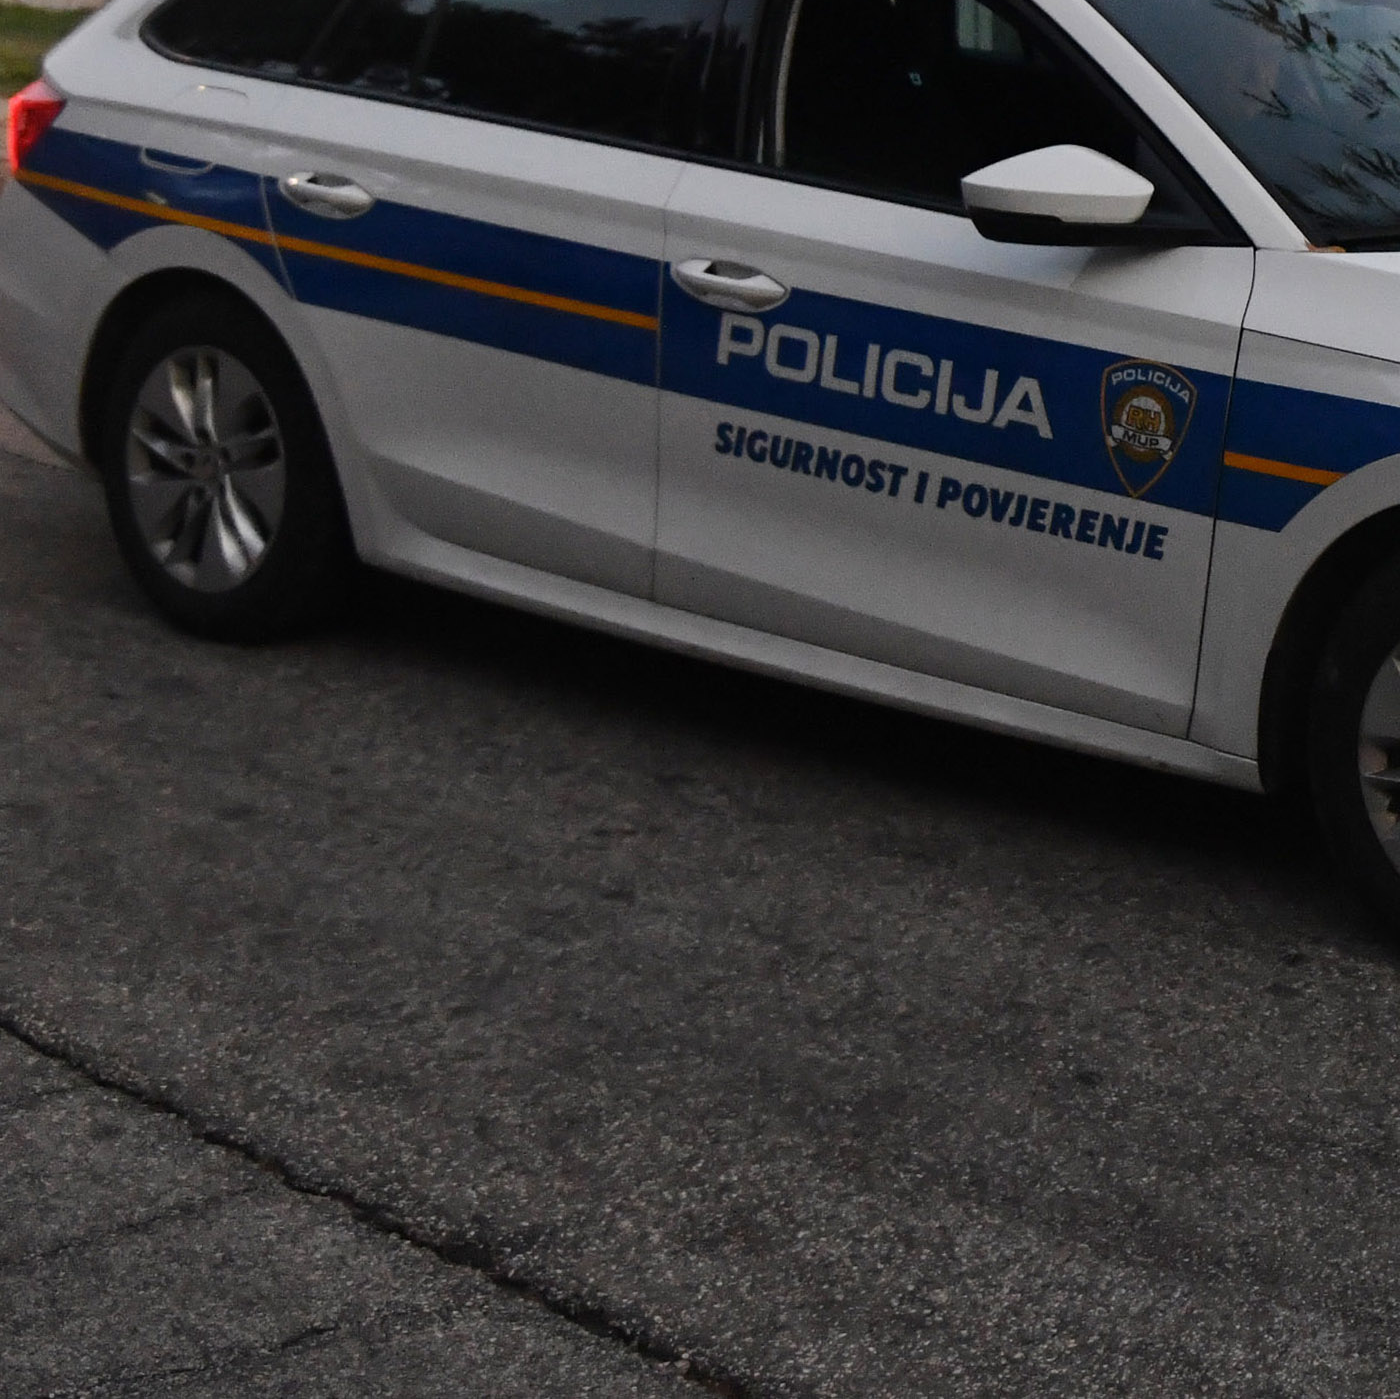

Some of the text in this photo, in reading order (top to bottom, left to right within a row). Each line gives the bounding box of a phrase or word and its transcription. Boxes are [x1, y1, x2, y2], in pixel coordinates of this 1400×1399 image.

[715, 313, 1054, 440] POLICIJA
[1112, 369, 1190, 404] POLICIJA
[1127, 406, 1162, 430] RH
[1123, 431, 1160, 447] MUP
[715, 421, 1170, 561] SIGURNOST I POVJERENJE
